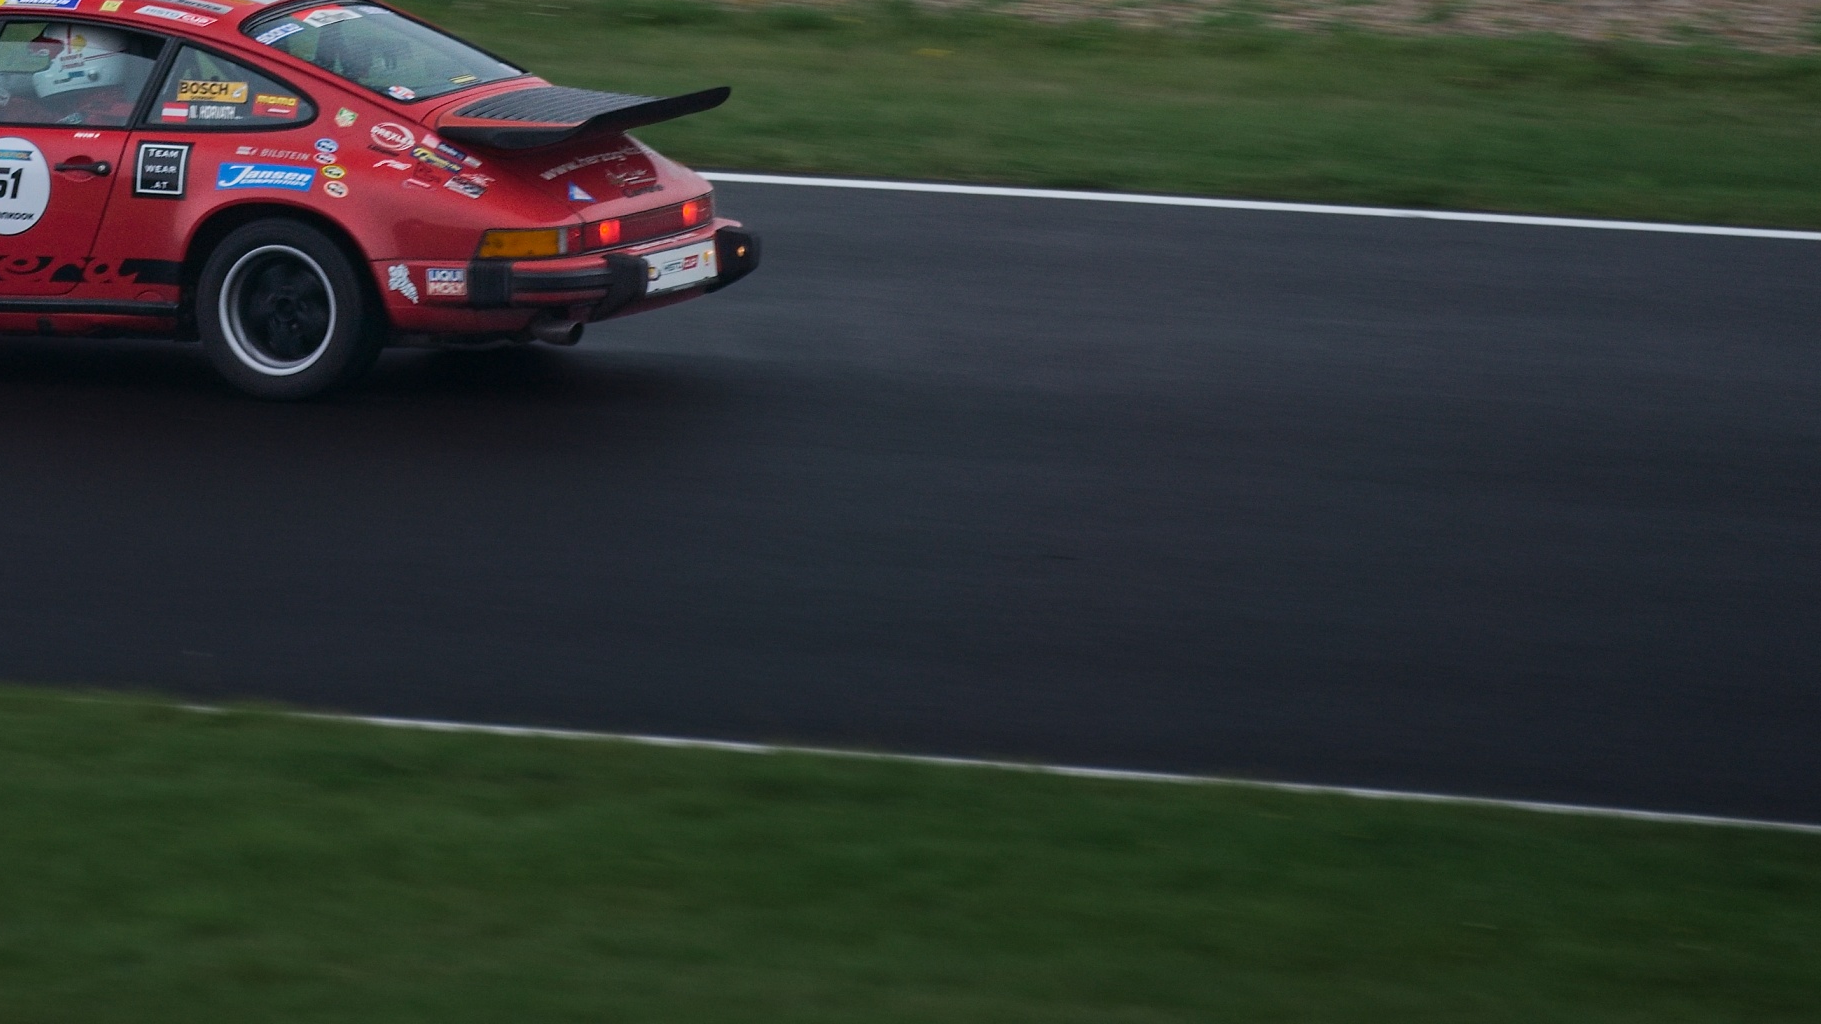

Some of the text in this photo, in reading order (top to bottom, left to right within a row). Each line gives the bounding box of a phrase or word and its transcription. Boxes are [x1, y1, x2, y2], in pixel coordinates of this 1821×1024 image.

[178, 0, 222, 12] Service
[180, 81, 228, 96] BOSCH
[147, 148, 179, 159] TEAM
[260, 148, 312, 162] BILSTEIN
[144, 164, 177, 175] WEAR
[218, 164, 313, 188] Jansen
[148, 180, 169, 190] .AT
[428, 270, 464, 281] LIQUI
[428, 282, 465, 295] MOLY
